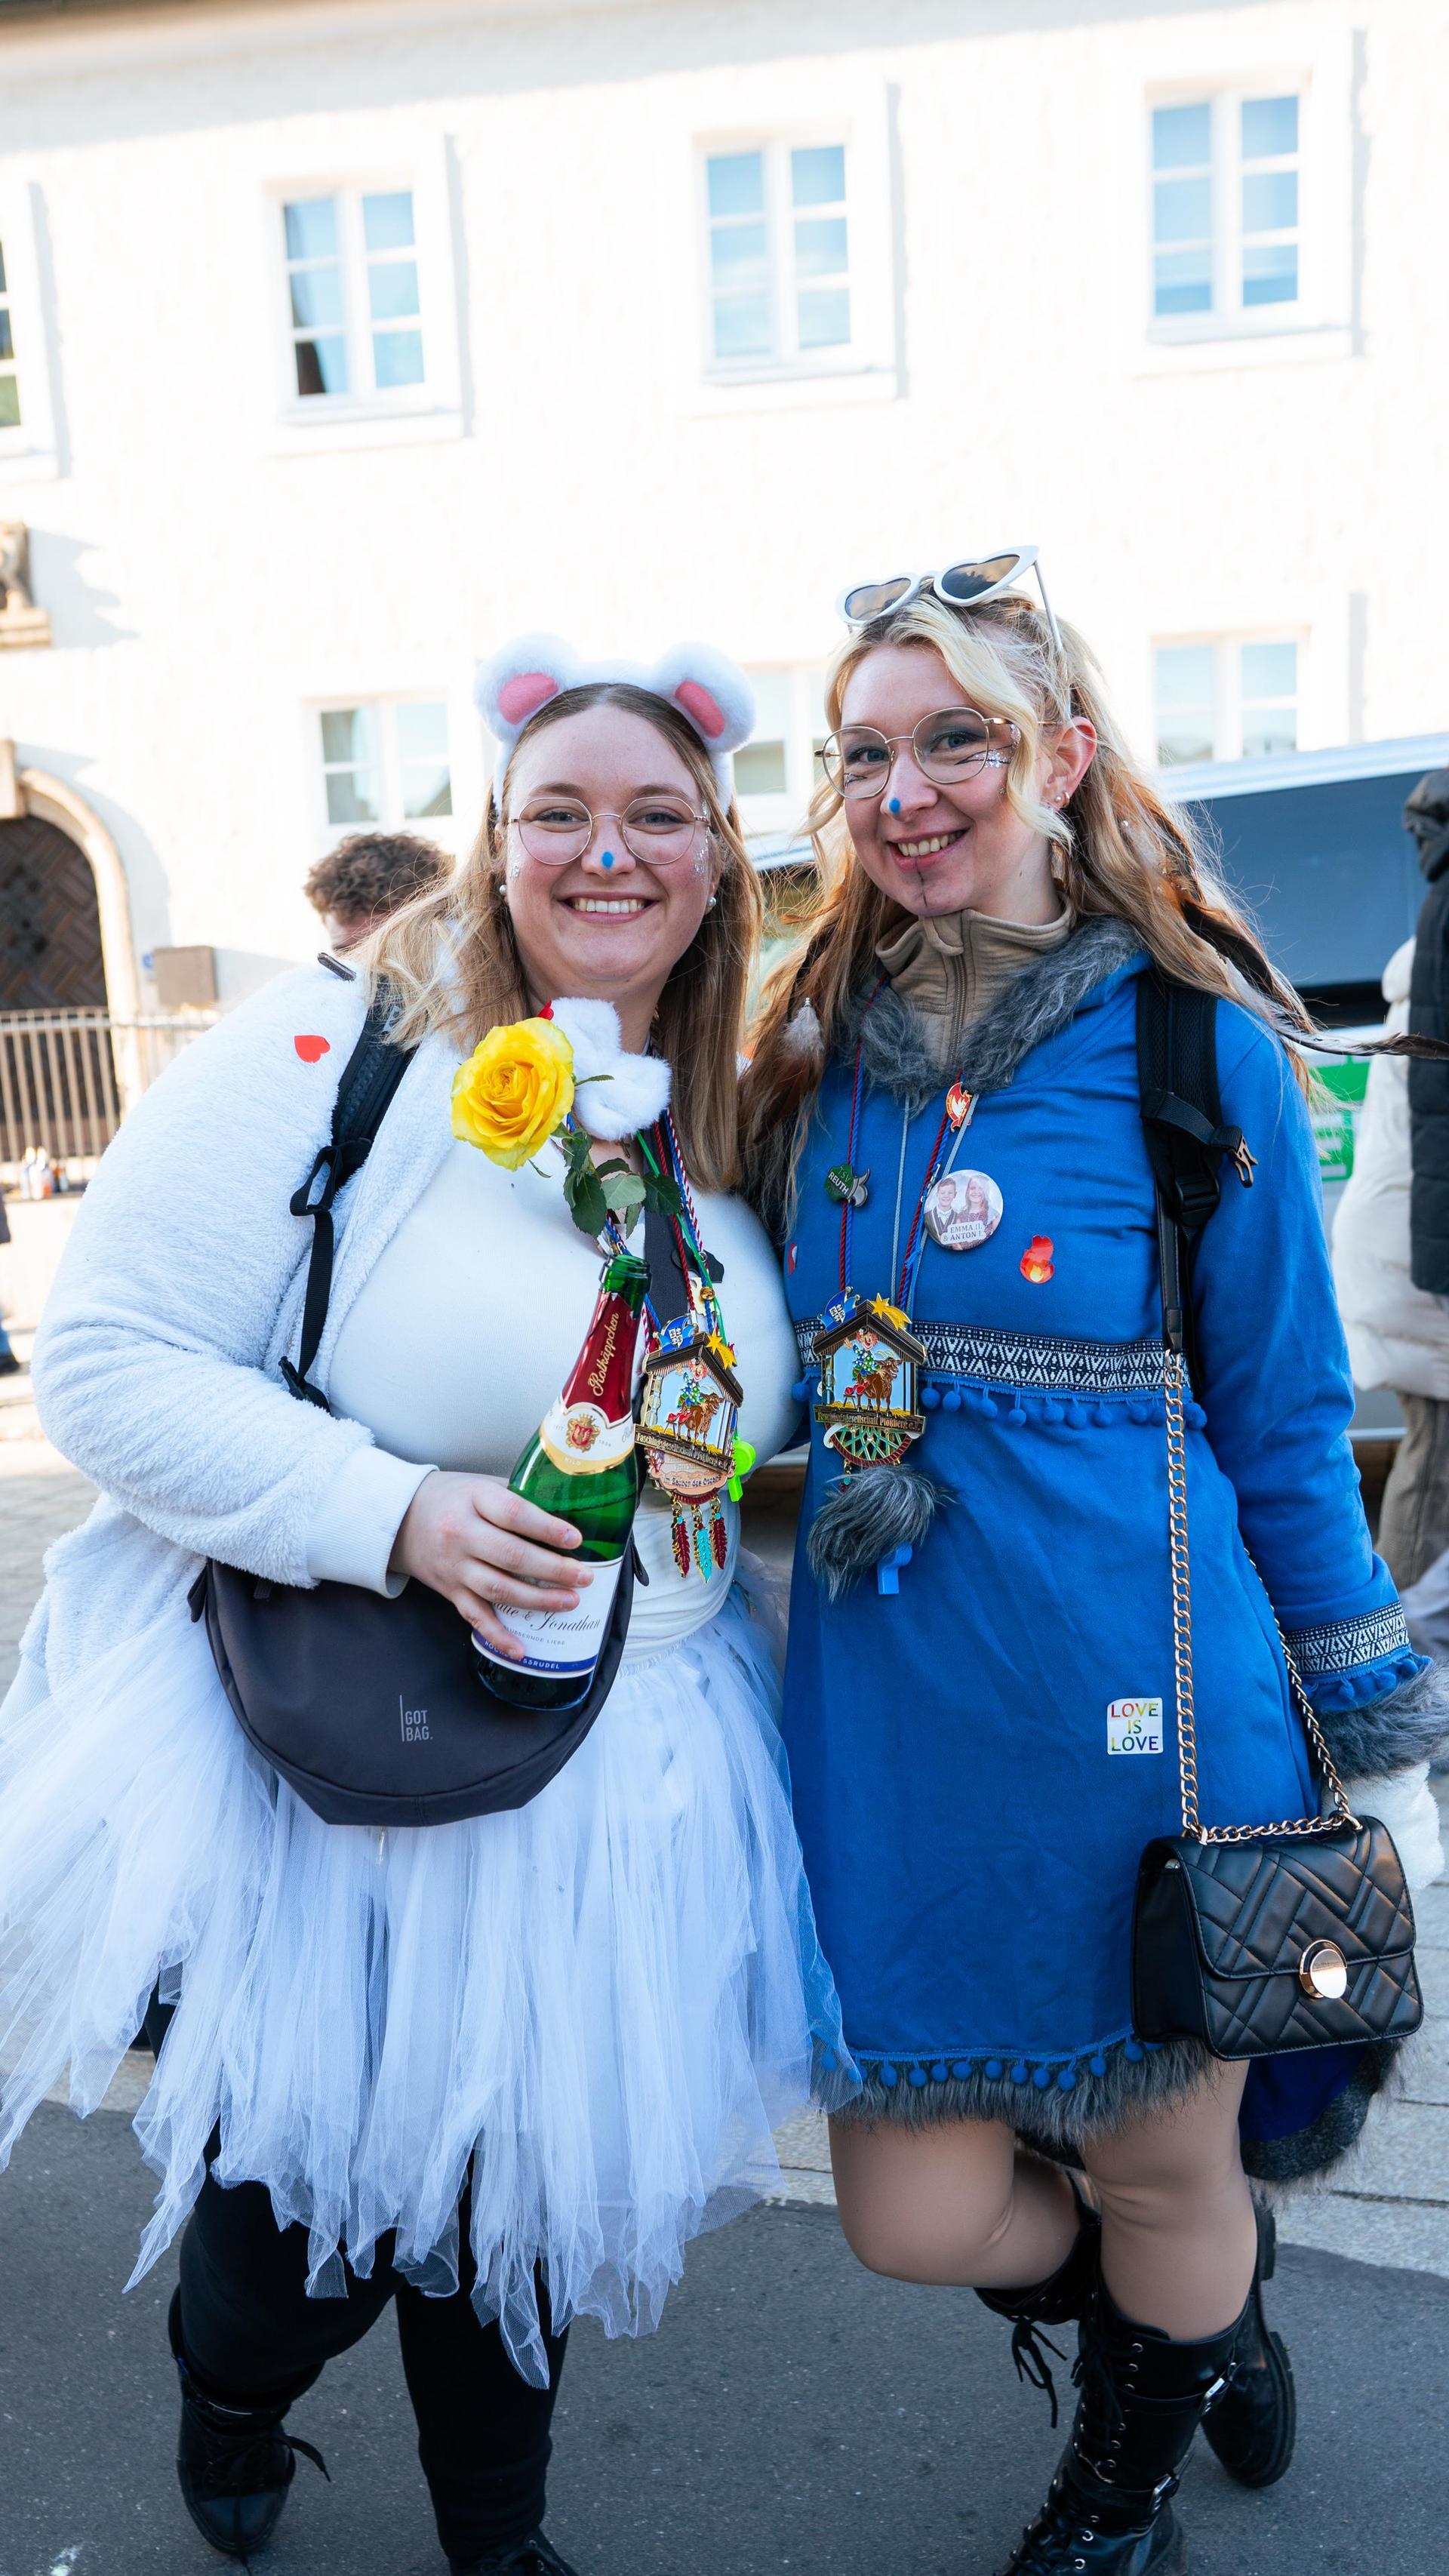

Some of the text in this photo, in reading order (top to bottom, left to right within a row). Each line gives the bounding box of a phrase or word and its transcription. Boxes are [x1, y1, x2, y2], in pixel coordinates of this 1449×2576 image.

[838, 1165, 851, 1183] TSV
[828, 1171, 849, 1195] REUTH
[950, 1224, 973, 1233] EMMA
[951, 1230, 977, 1241] ANTON
[587, 1312, 620, 1397] Rotkäppchen
[530, 1611, 601, 1631] Jonathan
[405, 1710, 428, 1725] GOT
[1111, 1703, 1159, 1718] LOVE
[406, 1725, 434, 1742] BAG.
[1128, 1719, 1142, 1734] IS
[1111, 1736, 1159, 1751] LOVE
